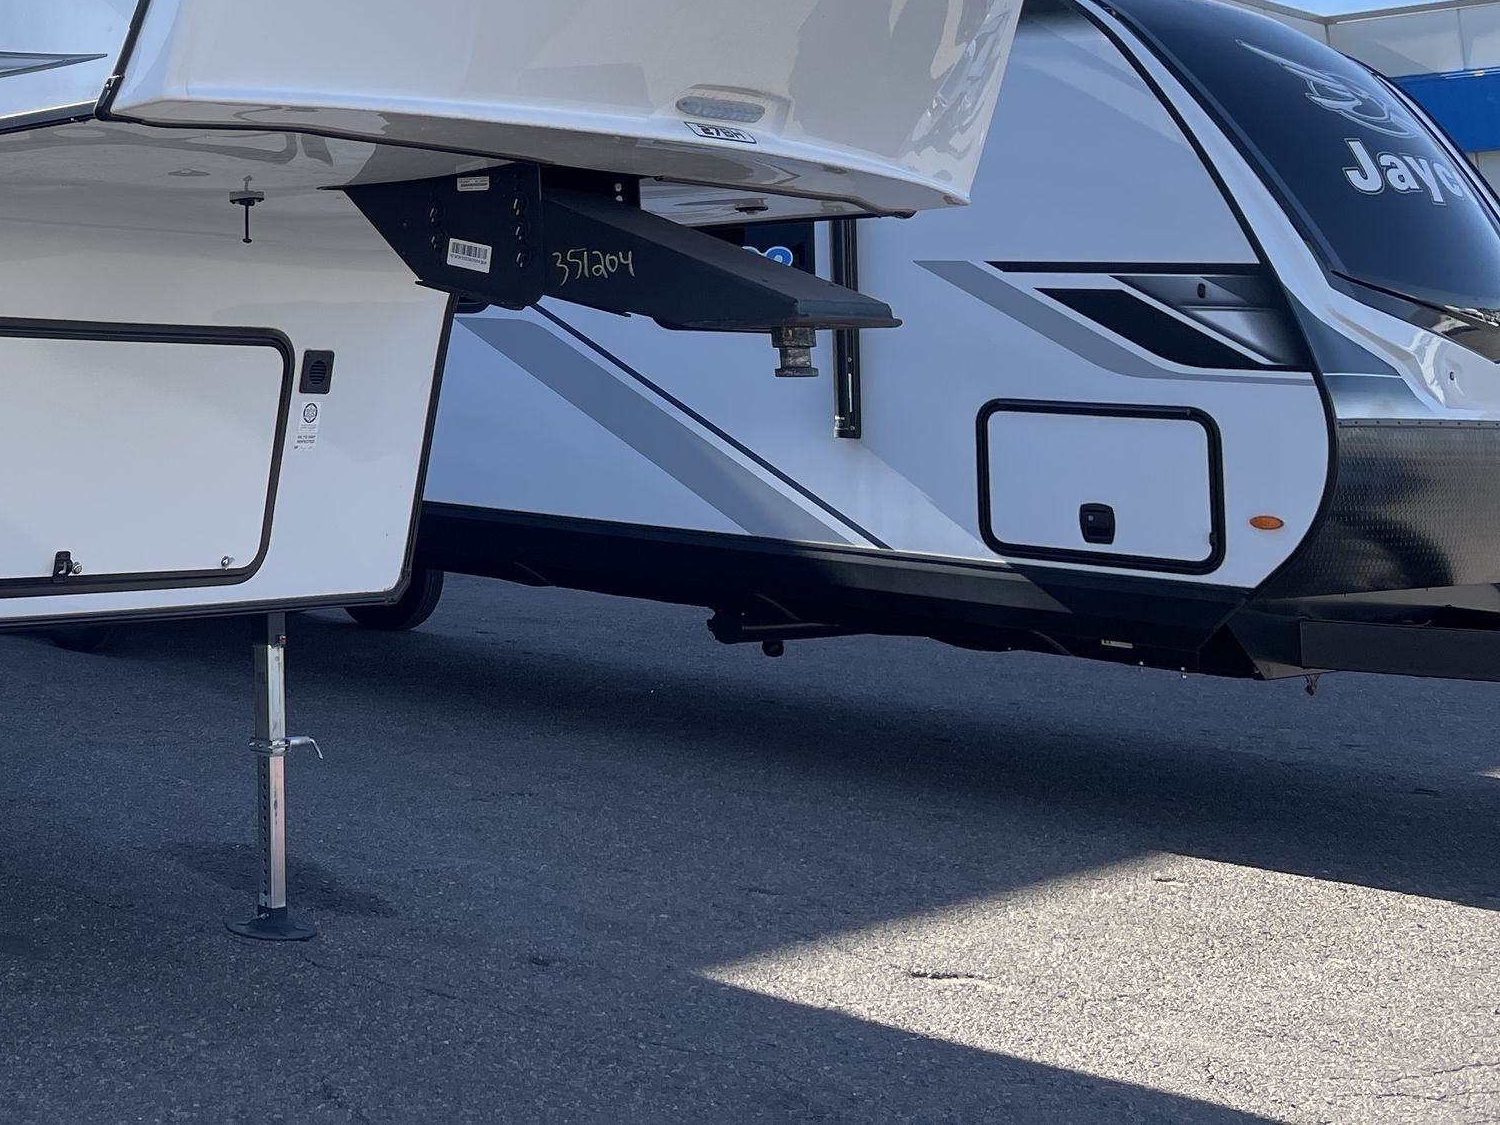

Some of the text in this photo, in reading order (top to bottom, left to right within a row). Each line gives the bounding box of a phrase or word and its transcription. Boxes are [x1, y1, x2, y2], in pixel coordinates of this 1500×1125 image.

[695, 123, 748, 140] 27BH
[1342, 138, 1472, 206] Jayc
[551, 247, 636, 287] 351204
